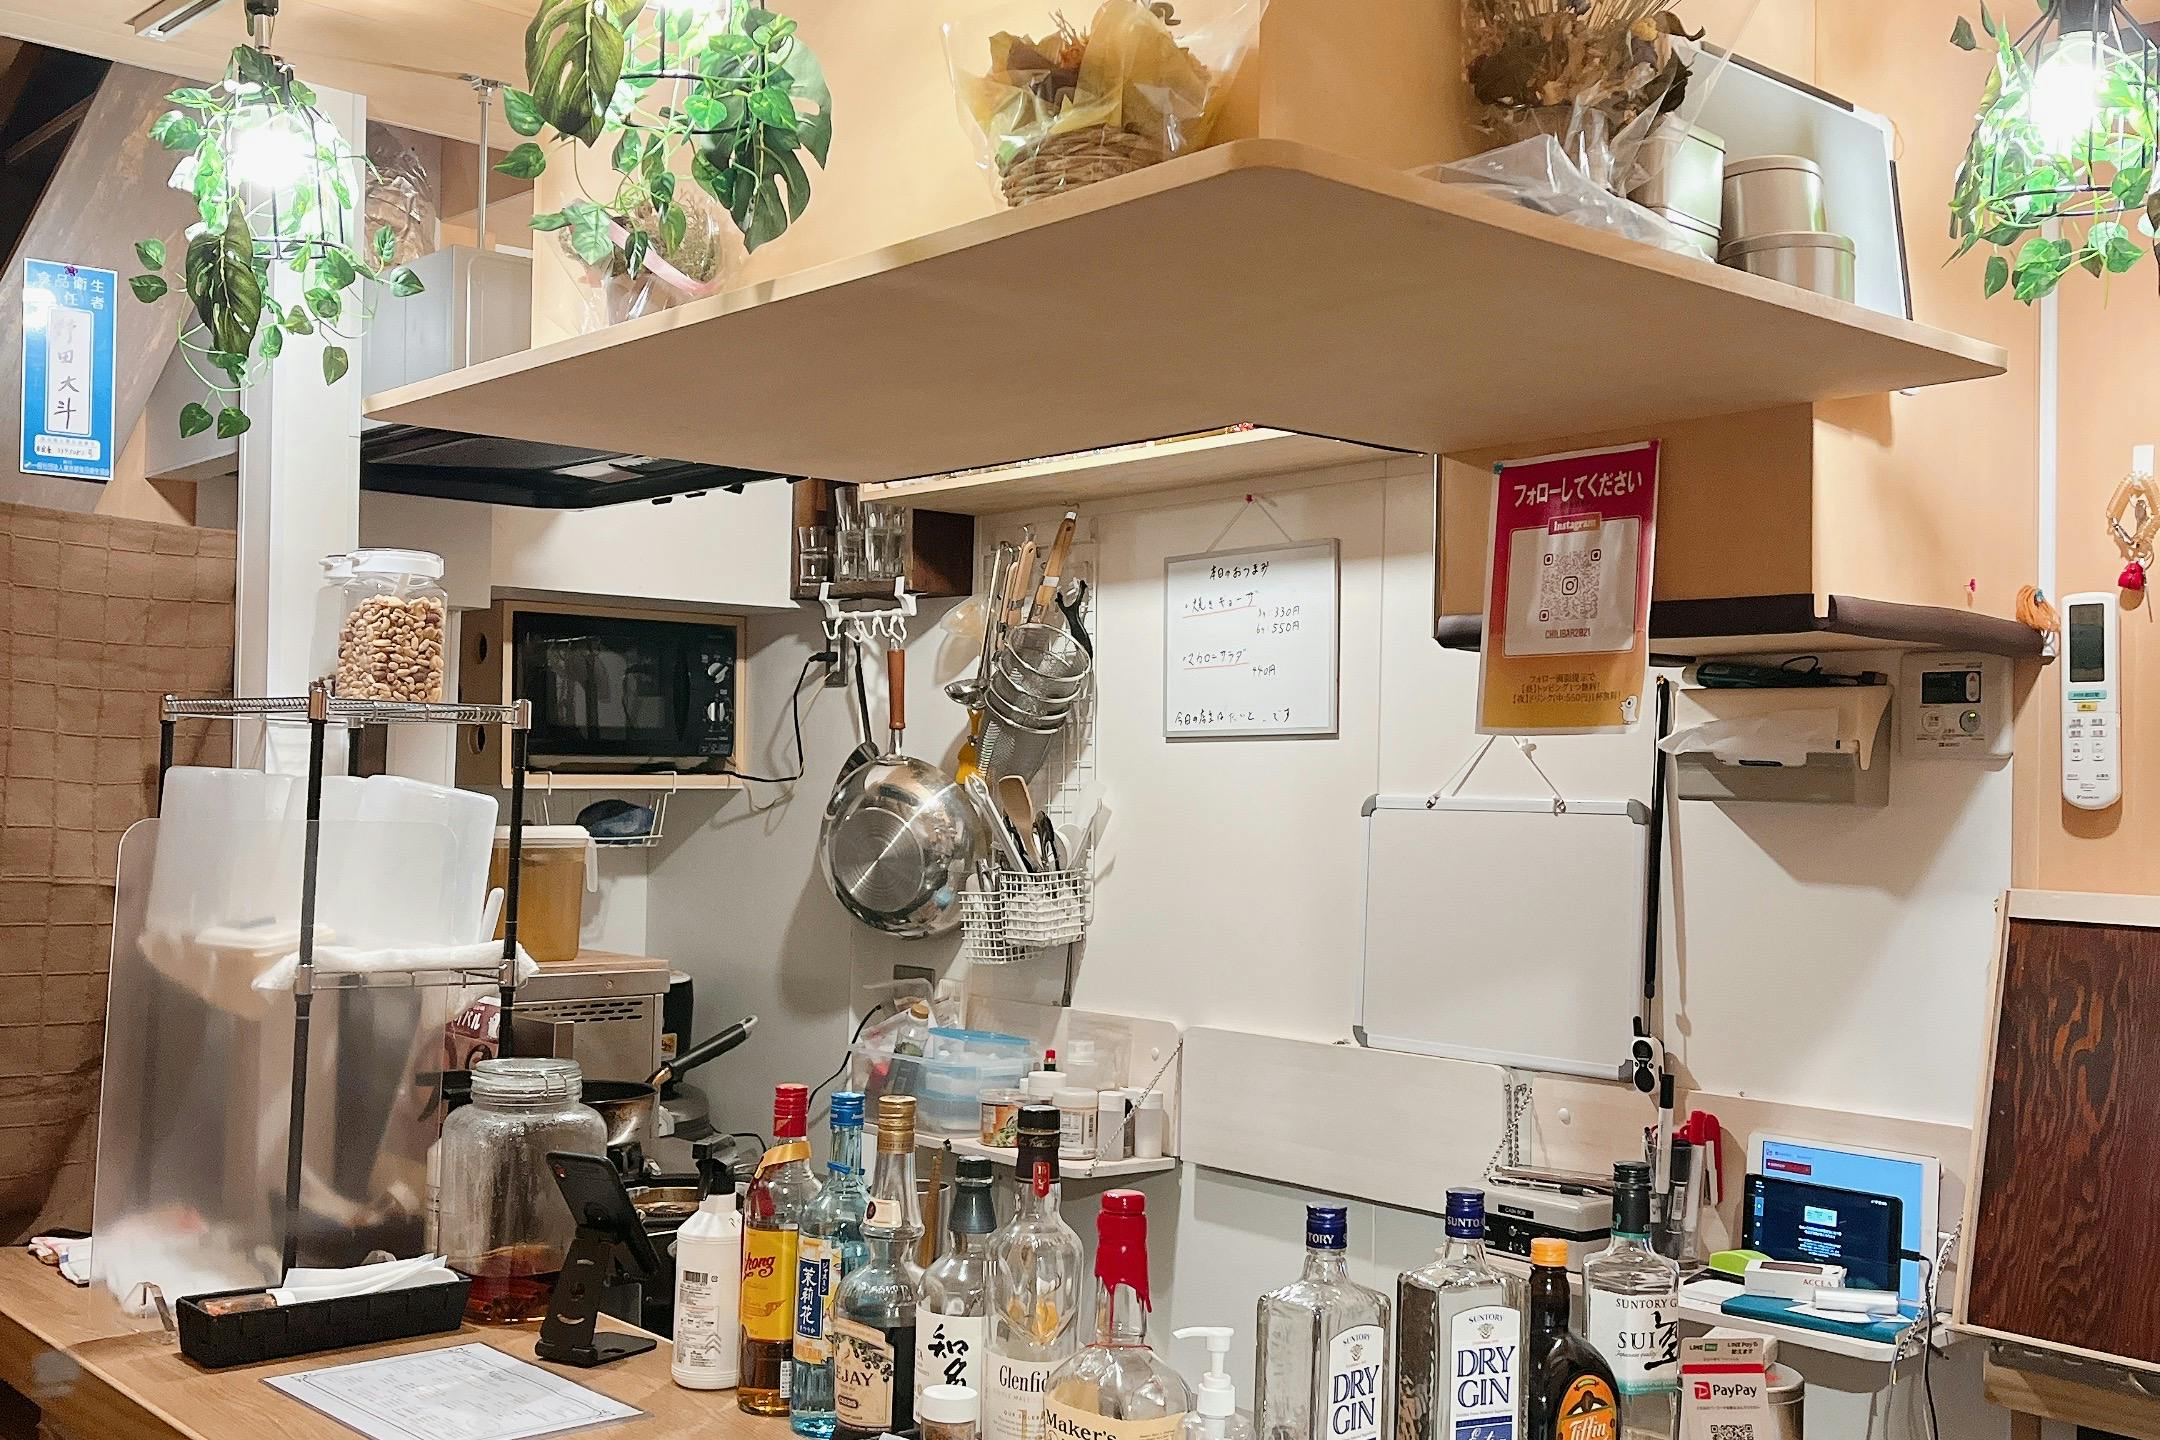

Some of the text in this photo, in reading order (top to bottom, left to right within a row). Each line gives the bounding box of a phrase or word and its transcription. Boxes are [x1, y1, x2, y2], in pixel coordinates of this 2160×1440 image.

[1513, 470, 1643, 508] フォローしてください
[1553, 519, 1597, 532] Instagram
[799, 1266, 818, 1326] 茉莉花
[1615, 1298, 1668, 1309] SUNTORY
[1468, 1313, 1504, 1323] SUNTORY
[1617, 1331, 1656, 1350] SUI
[1457, 1345, 1516, 1378] DRY
[1332, 1364, 1380, 1404] DRY
[1457, 1376, 1511, 1408] GIN
[1712, 1383, 1757, 1398] PayPay
[1045, 1408, 1117, 1440] Maker's
[1332, 1397, 1376, 1435] GIN
